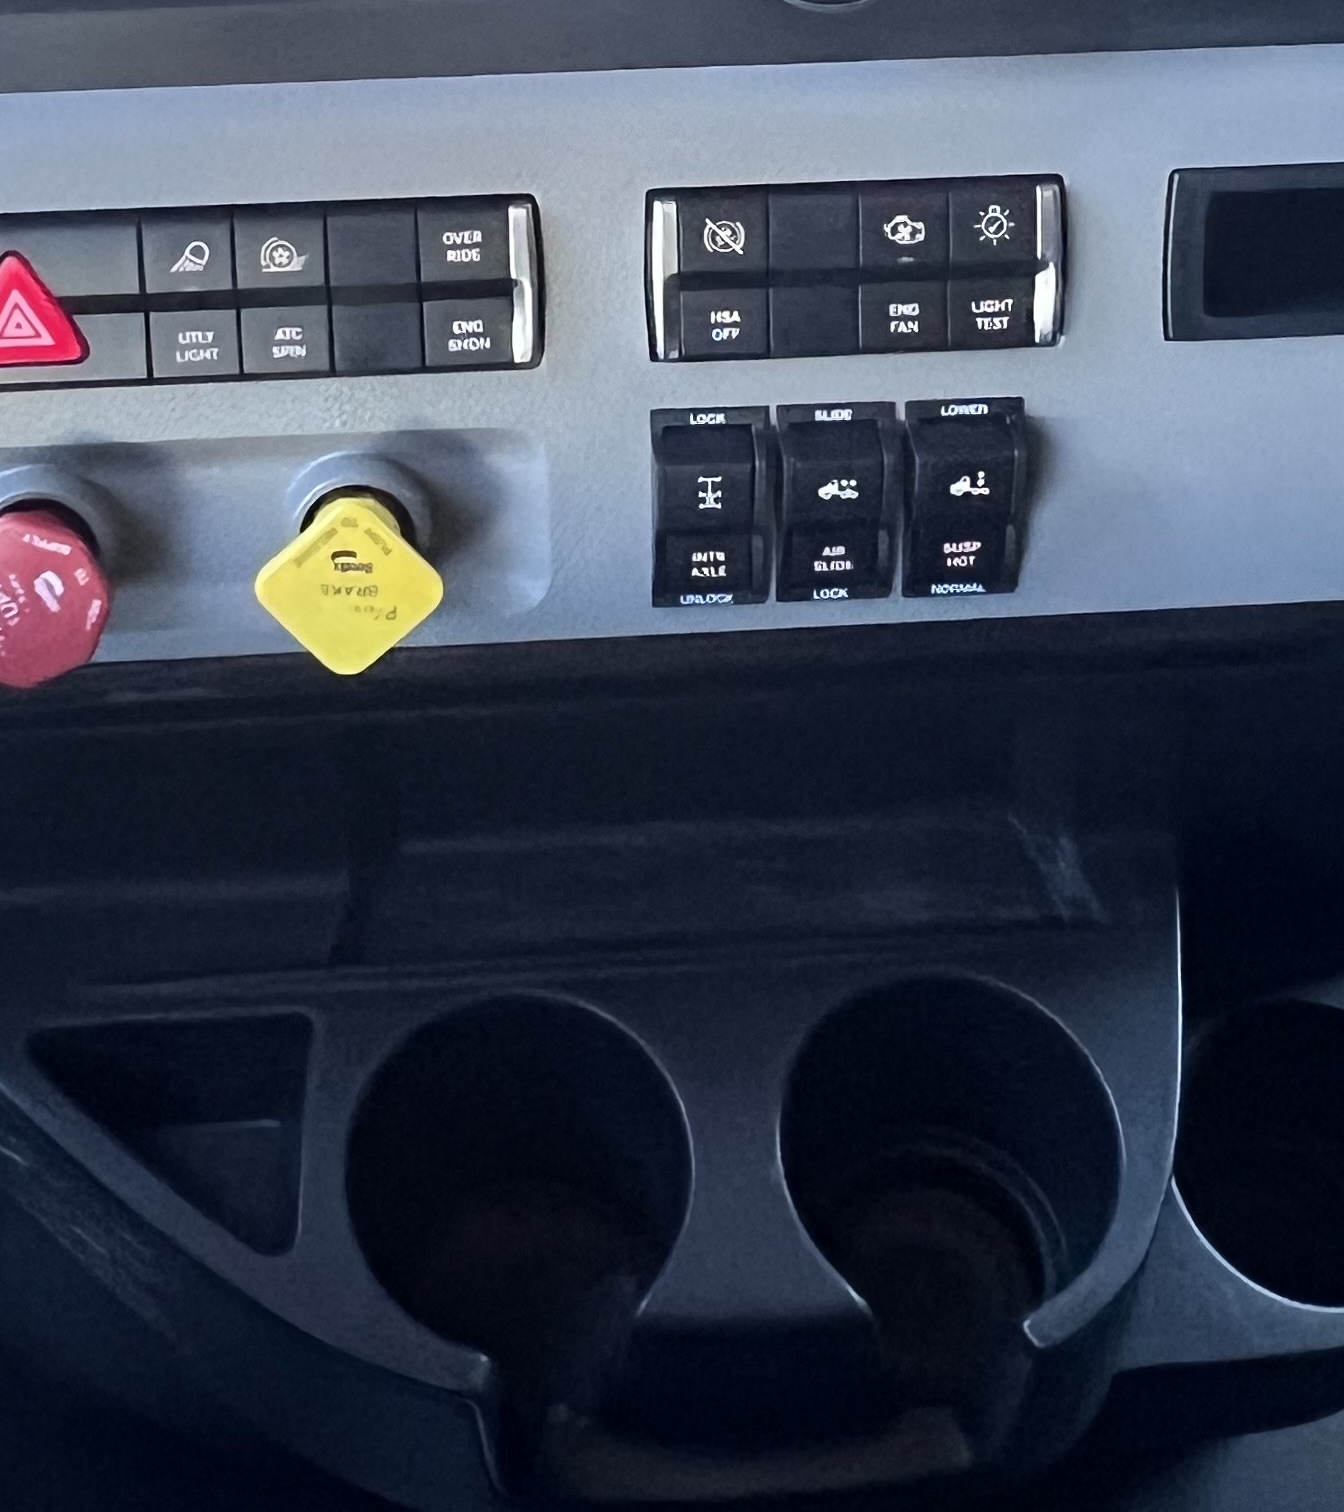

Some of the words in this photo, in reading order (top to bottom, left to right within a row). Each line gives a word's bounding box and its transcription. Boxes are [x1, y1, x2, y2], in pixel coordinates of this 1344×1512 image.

[442, 230, 482, 245] OVER
[446, 248, 481, 262] RIDE
[971, 298, 1014, 313] LIGHT
[710, 310, 742, 325] HSA
[975, 316, 1010, 330] TEST
[274, 326, 304, 341] ATC
[889, 320, 919, 333] FAN
[177, 330, 215, 344] UTLY
[711, 327, 741, 342] OFF
[175, 347, 219, 363] LIGHT
[689, 412, 727, 426] LOCK
[813, 587, 849, 600] LOCK
